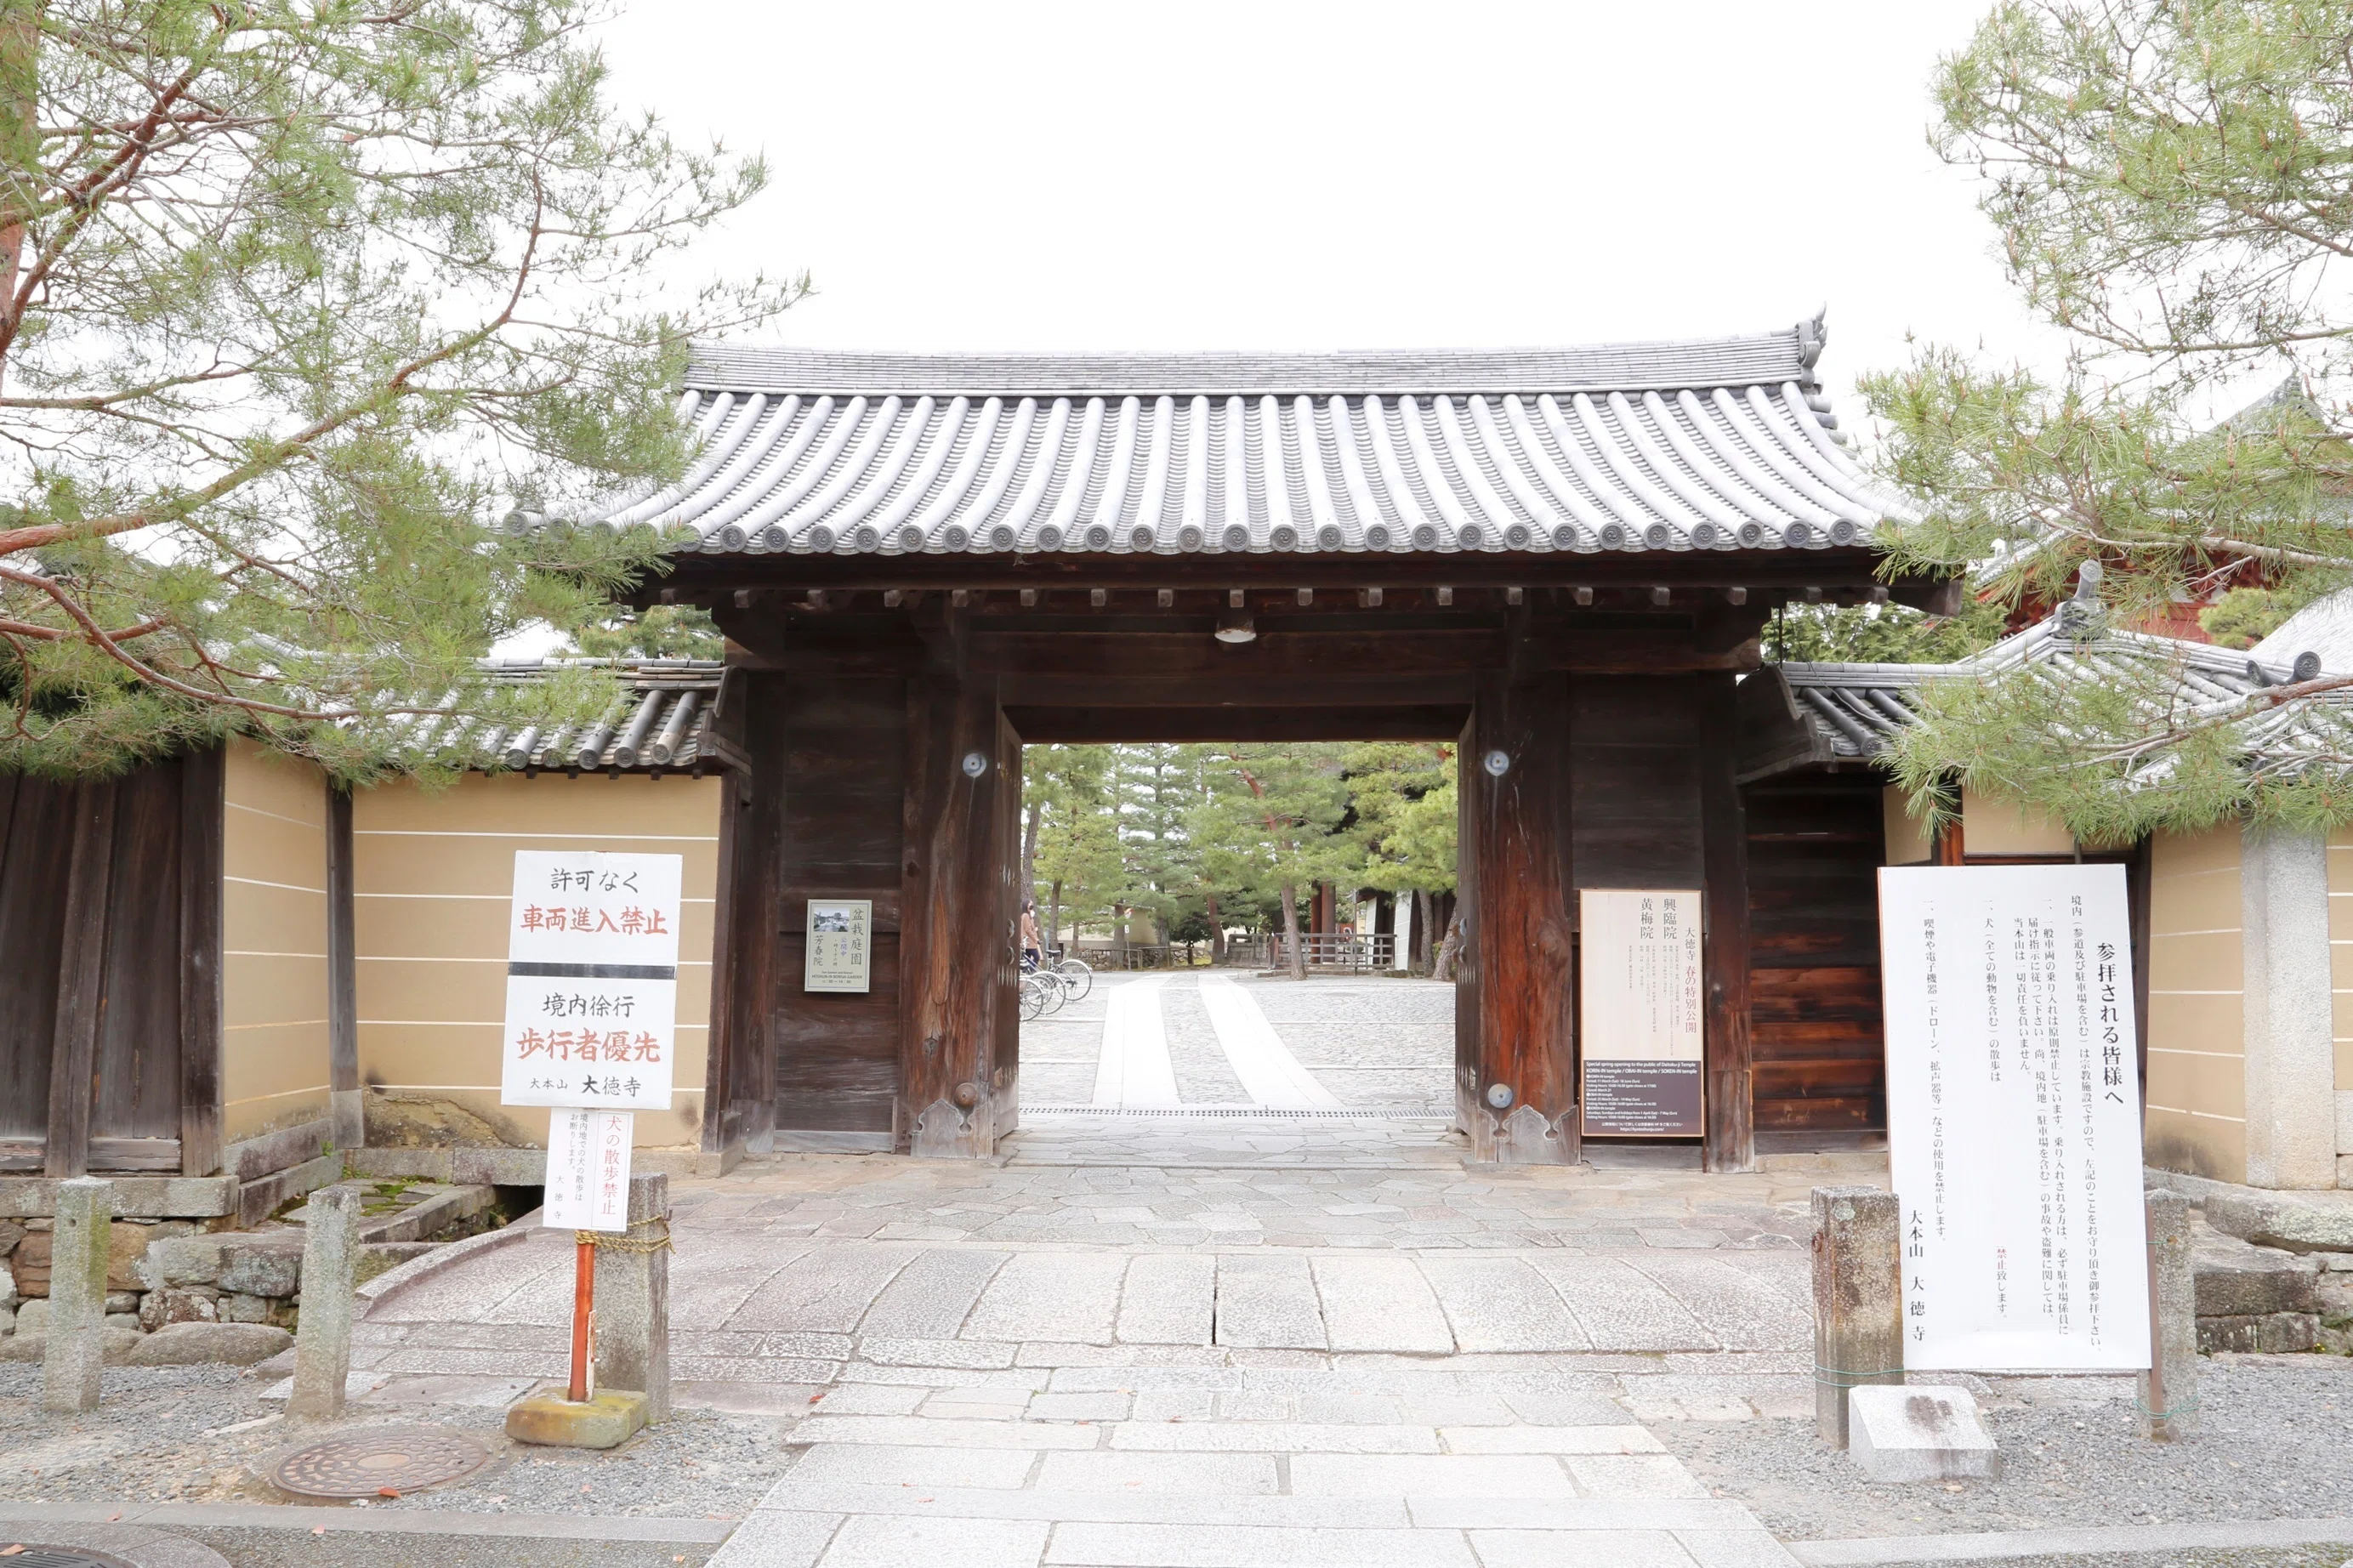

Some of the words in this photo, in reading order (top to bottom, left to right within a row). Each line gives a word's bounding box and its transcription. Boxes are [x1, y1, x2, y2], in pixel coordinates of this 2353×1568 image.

[549, 867, 639, 894] 許可なく
[520, 903, 668, 935] 車両進入禁止
[850, 907, 864, 966] 盆栽庭園
[1640, 898, 1654, 940] 黄梅院
[1663, 898, 1677, 940] 興臨院
[1685, 927, 1696, 961] 大徳寺
[541, 992, 636, 1018] 境内徐行
[1685, 966, 1697, 1034] 春の特別公開
[2013, 918, 2031, 1076] 当本山は一切責任を負いません。
[515, 1027, 662, 1063] 歩行者優先
[2096, 942, 2124, 1105] 参拝される皆様へ
[529, 1077, 569, 1090] 大本山
[581, 1075, 642, 1098] 大徳寺
[567, 1113, 579, 1170] お断りします。
[575, 1113, 589, 1202] 境内地での犬の散歩は
[600, 1115, 622, 1215] 犬の散歩禁止
[554, 1175, 565, 1220] 大徳寺
[1908, 1209, 1923, 1258] 大本山
[1996, 1247, 2007, 1319] 禁止致します。
[1910, 1275, 1925, 1342] 大徳寺
